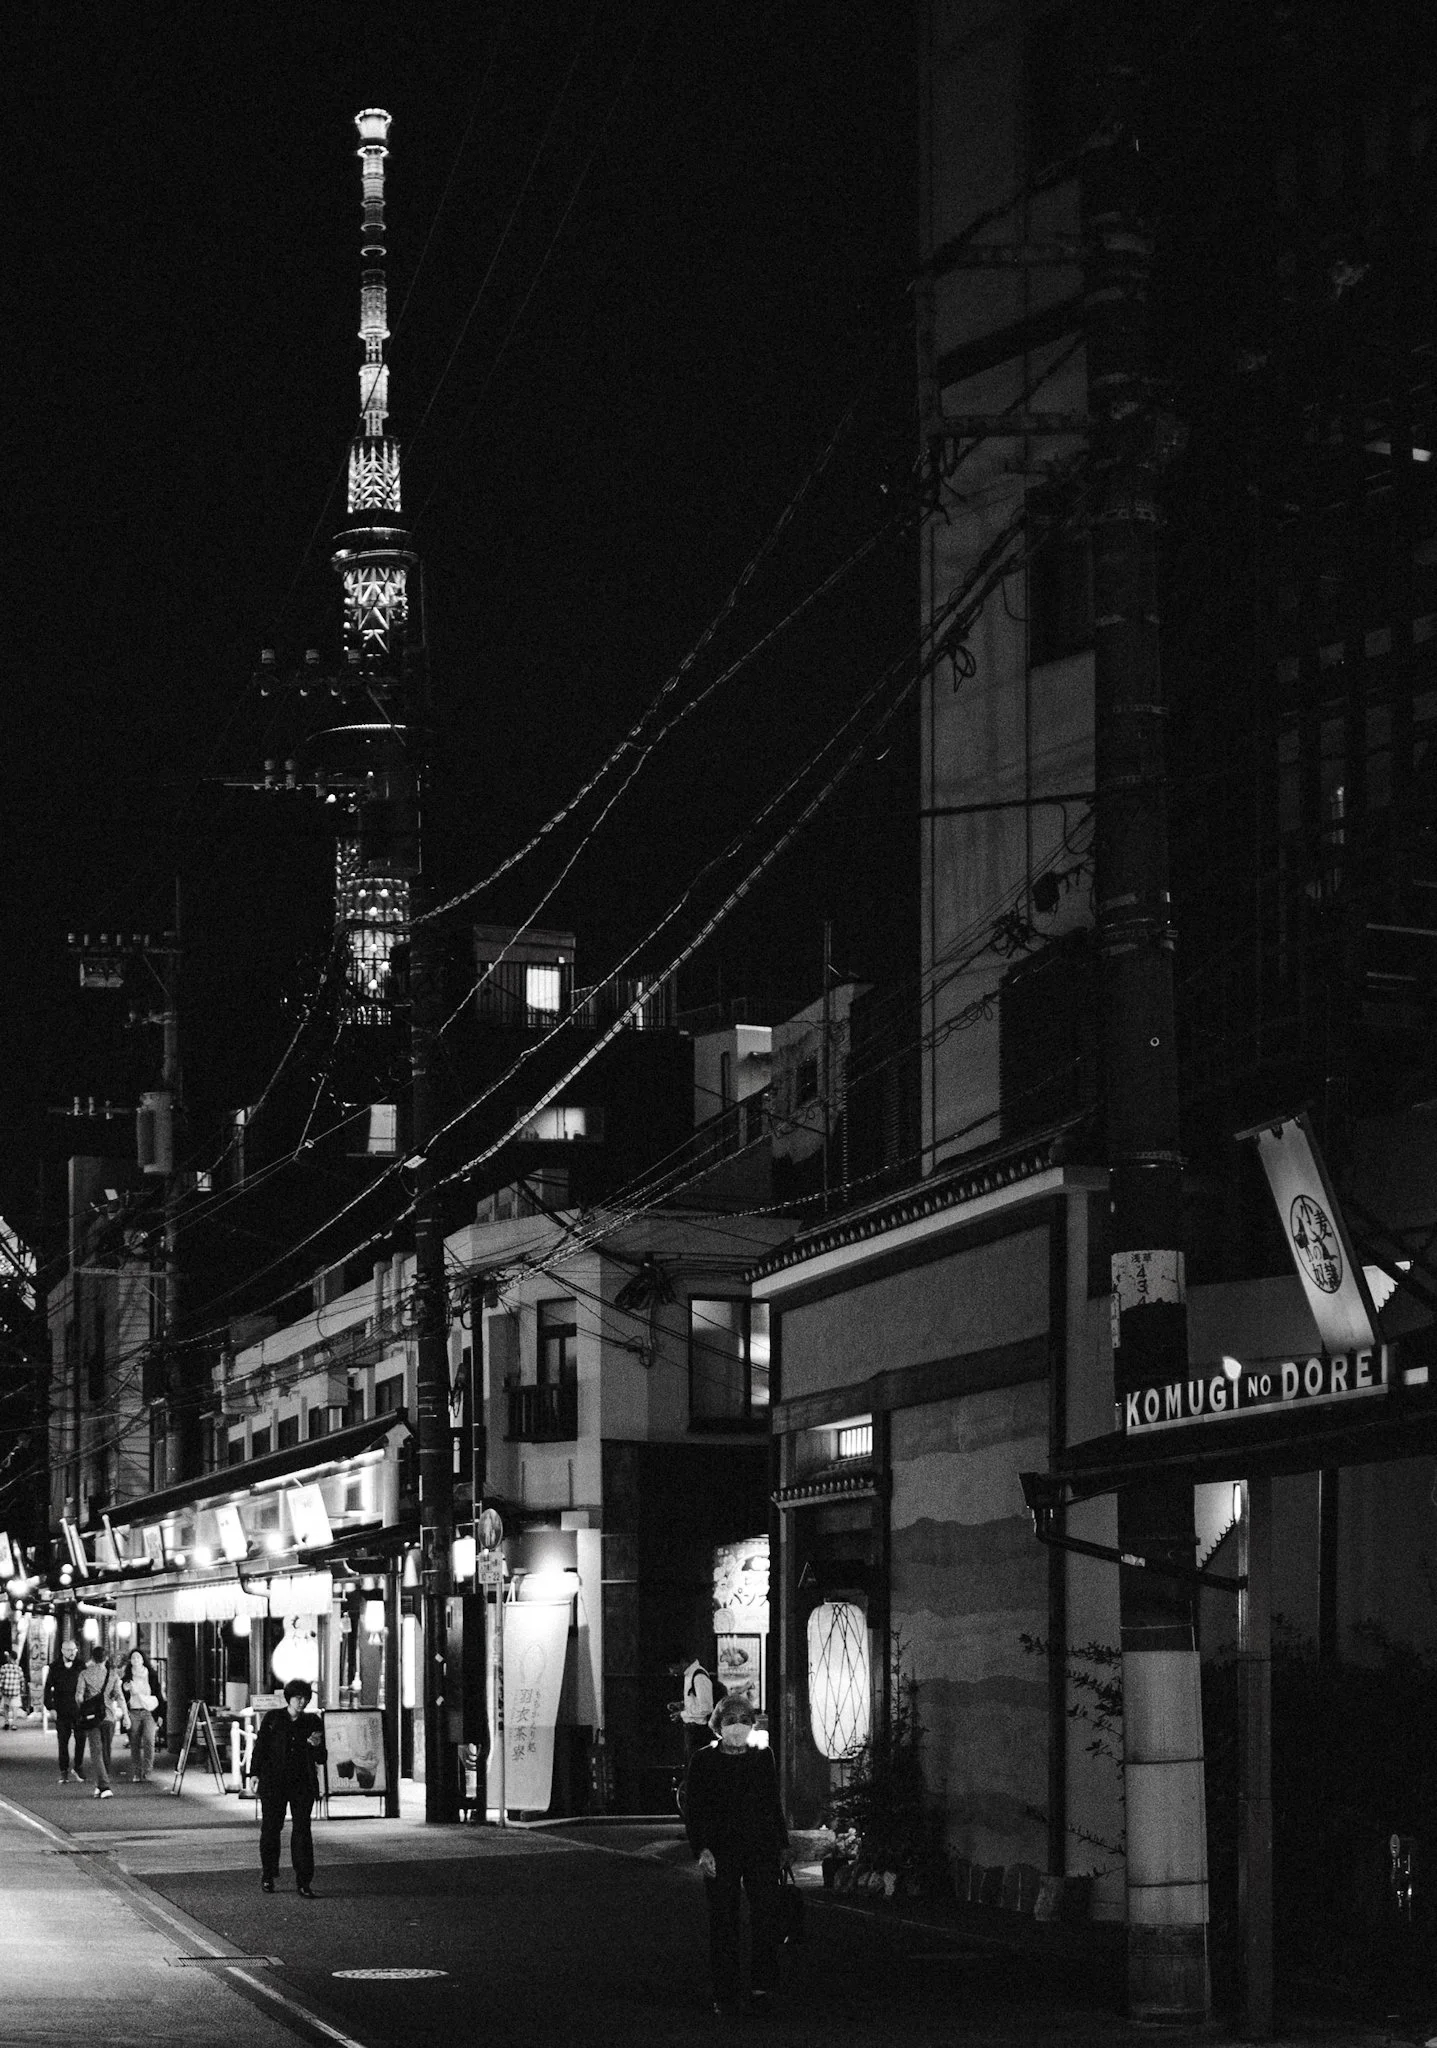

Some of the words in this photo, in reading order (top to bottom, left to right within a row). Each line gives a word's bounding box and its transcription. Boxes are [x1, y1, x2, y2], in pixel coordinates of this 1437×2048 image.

[1300, 1197, 1332, 1240] 小麦
[1131, 1253, 1152, 1263] 浅草
[1126, 1376, 1239, 1427] KOMUGI
[1248, 1374, 1272, 1398] NO
[1281, 1344, 1388, 1401] DOREI
